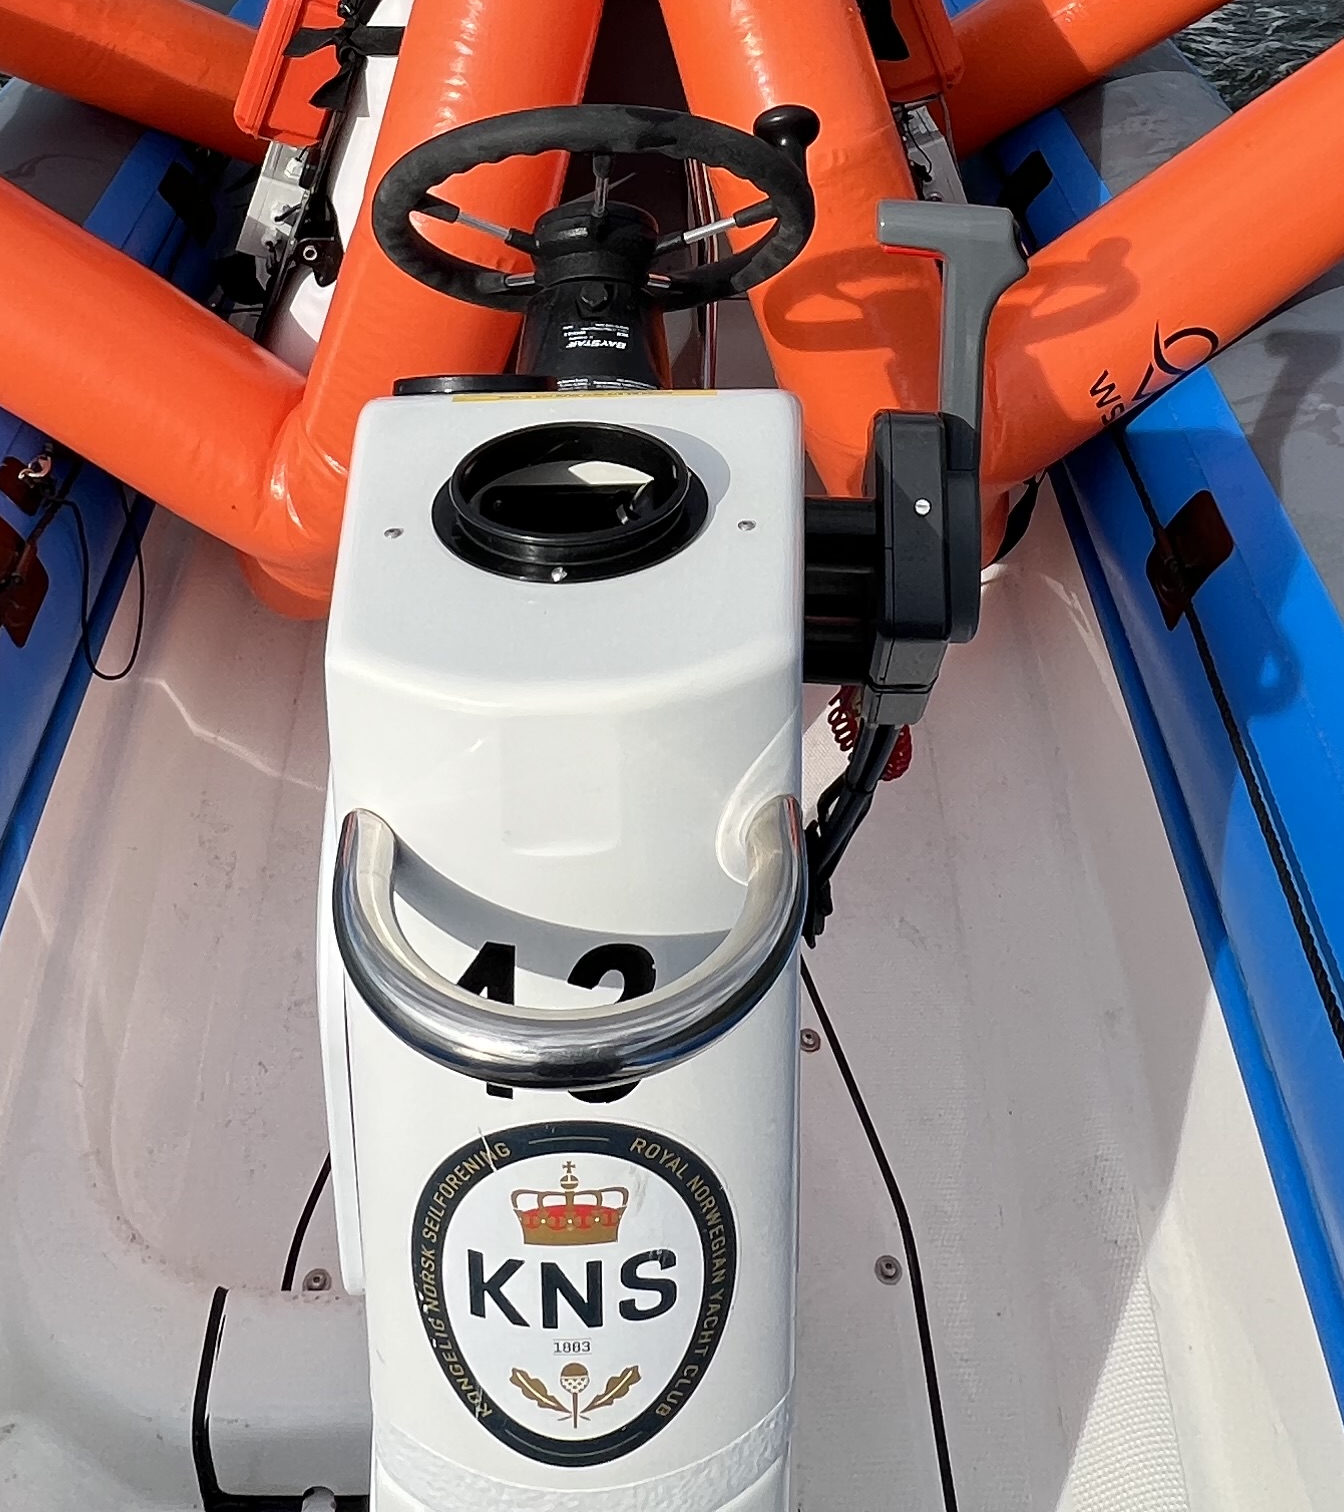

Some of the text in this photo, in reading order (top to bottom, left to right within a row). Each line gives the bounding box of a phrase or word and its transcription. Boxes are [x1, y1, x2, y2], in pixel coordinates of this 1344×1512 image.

[420, 1141, 511, 1419] KONGELIG NORSK SEILFORENING
[467, 1248, 678, 1330] KNS
[630, 1137, 726, 1418] ROYAL NORWEGIAN YACHT CLUB
